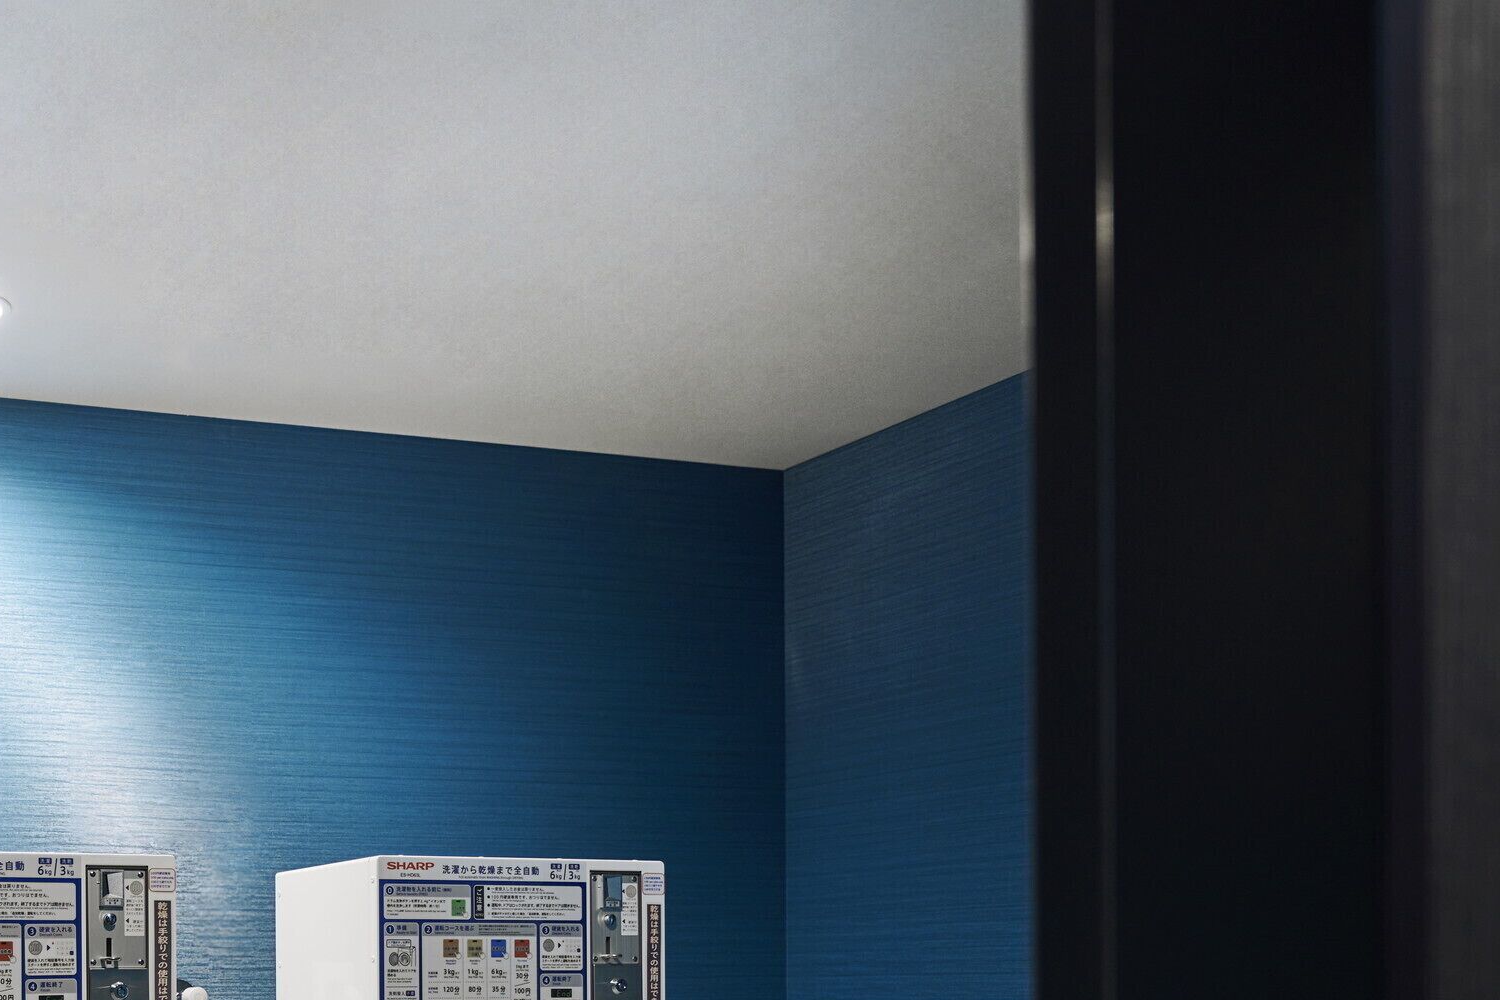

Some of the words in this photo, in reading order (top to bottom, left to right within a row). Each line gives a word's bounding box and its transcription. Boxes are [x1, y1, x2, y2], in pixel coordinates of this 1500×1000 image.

[386, 861, 435, 870] SHARP
[442, 865, 540, 876] 洗濯から乾燥まで全自動
[38, 866, 52, 876] 6kg
[60, 866, 74, 876] 3kg
